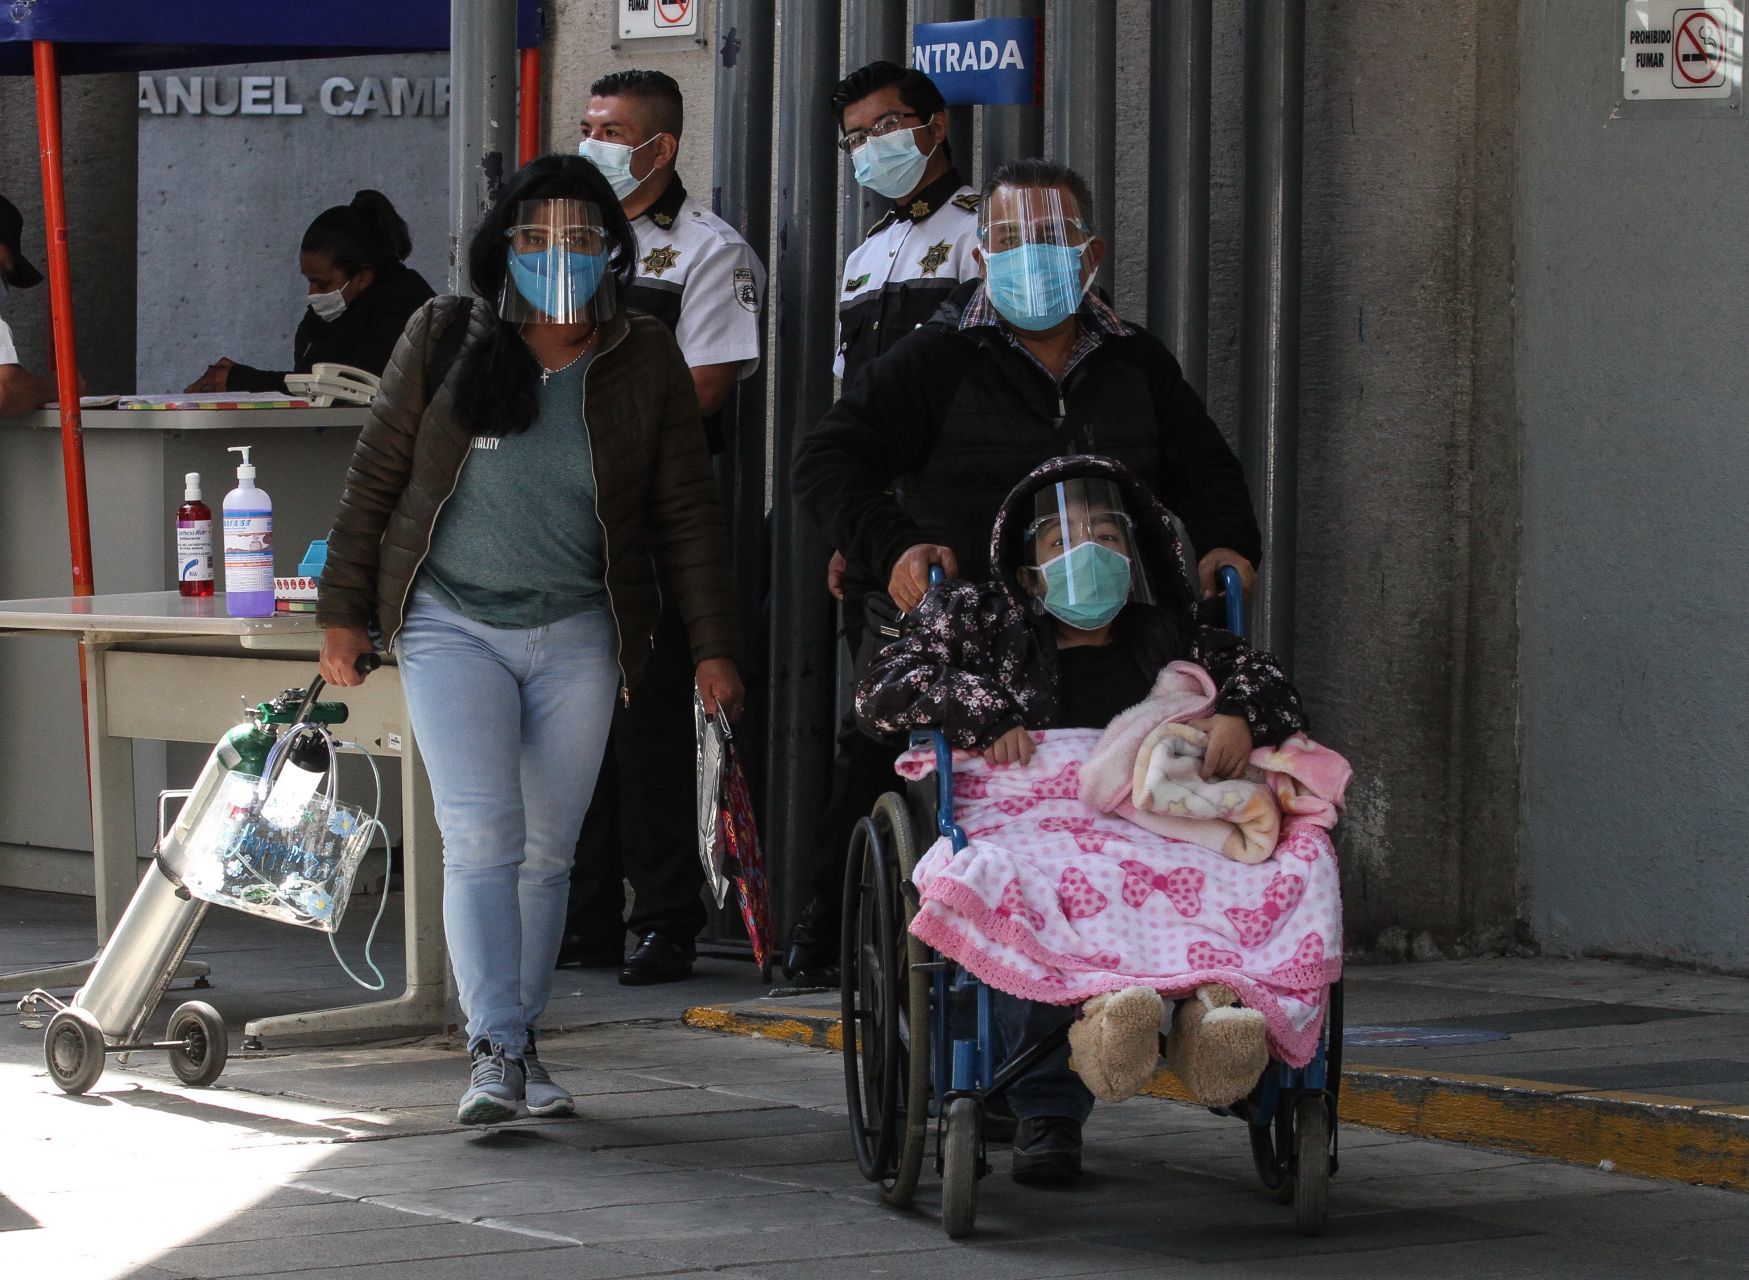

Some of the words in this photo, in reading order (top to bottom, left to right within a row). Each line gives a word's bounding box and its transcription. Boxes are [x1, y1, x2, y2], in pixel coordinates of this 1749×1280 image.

[628, 0, 648, 11] FUMAR
[1630, 30, 1671, 44] PROHIBIDO
[912, 40, 1025, 74] NTRADA
[1636, 53, 1664, 68] FUMAR
[471, 436, 500, 449] TALITY
